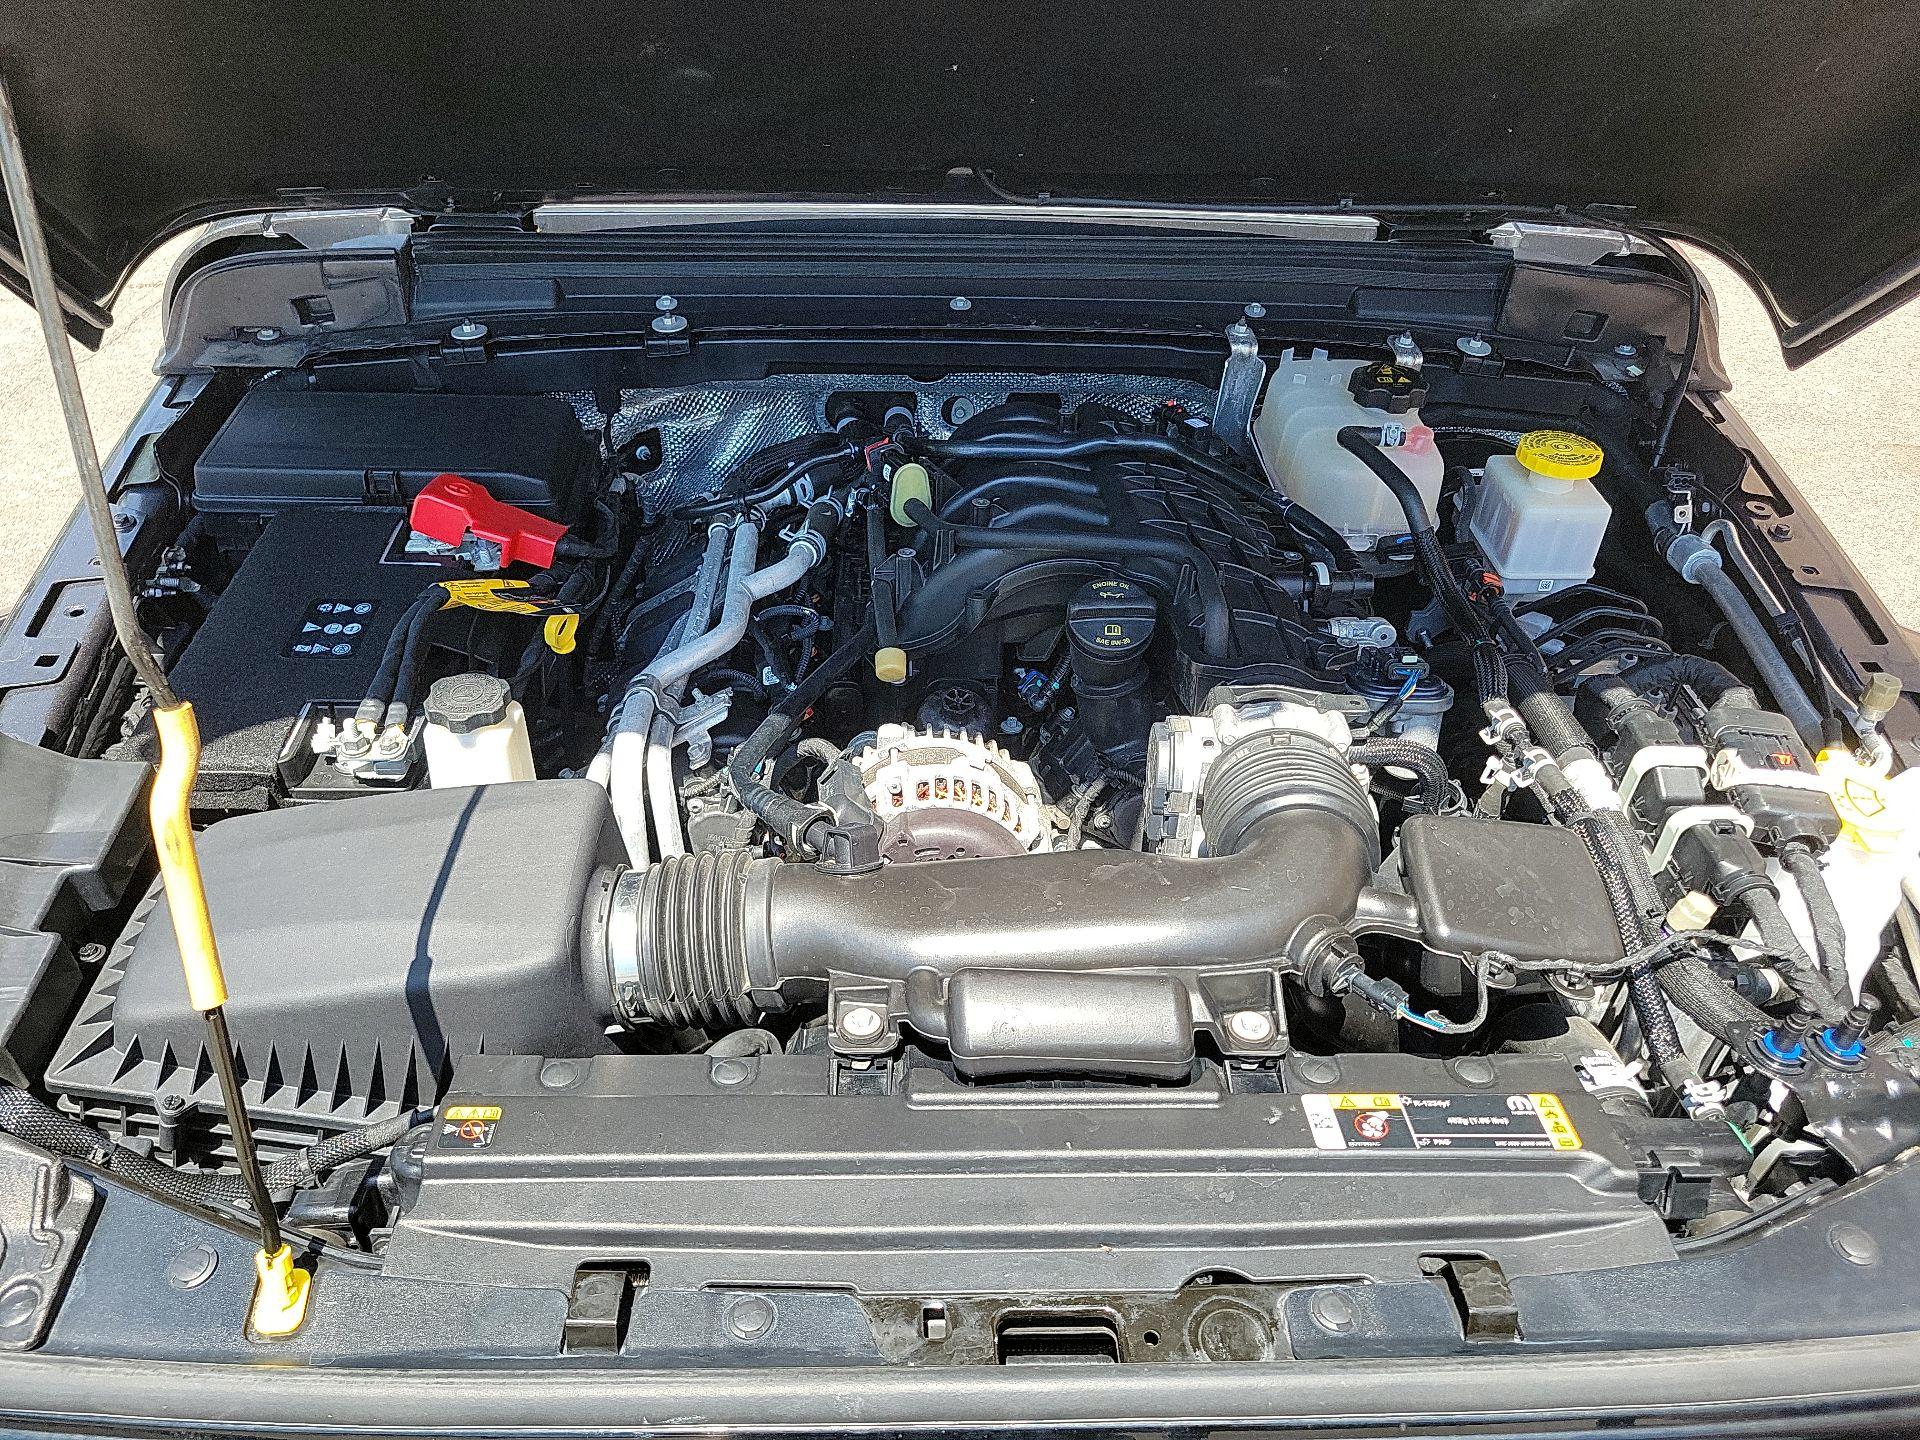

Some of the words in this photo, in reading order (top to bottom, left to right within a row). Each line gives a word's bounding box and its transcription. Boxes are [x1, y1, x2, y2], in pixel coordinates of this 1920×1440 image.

[1091, 581, 1118, 590] ENGINE
[1119, 582, 1130, 590] OIL
[1095, 637, 1110, 646] SAE
